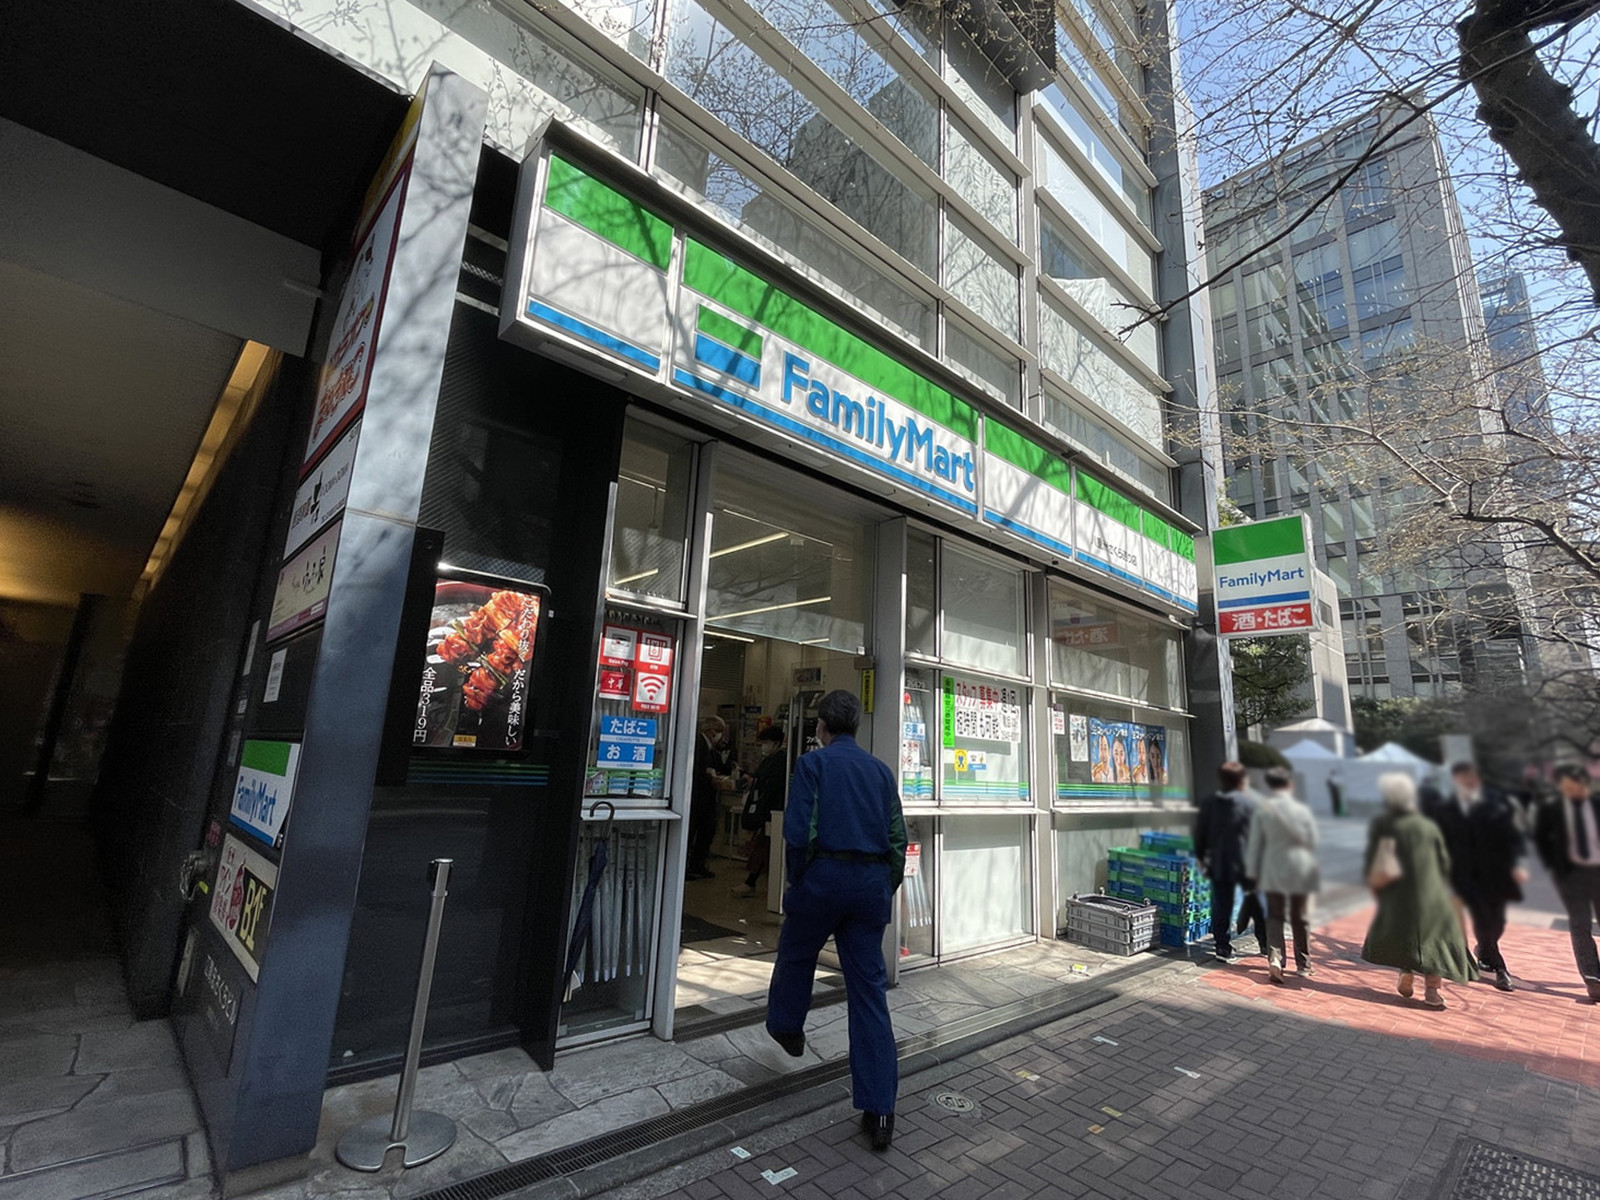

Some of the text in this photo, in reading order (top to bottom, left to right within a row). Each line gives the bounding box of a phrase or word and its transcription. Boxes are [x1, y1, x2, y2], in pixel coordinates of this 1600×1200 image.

[780, 351, 975, 492] FamilyMart
[1220, 567, 1305, 588] FamilyMart
[517, 597, 534, 662] こだわり抜く
[1232, 607, 1306, 630] 酒・たばこ
[413, 666, 437, 743] 全品319円
[505, 669, 526, 745] だから美味しい
[610, 718, 648, 735] たばこ
[234, 775, 277, 827] FamilyMart
